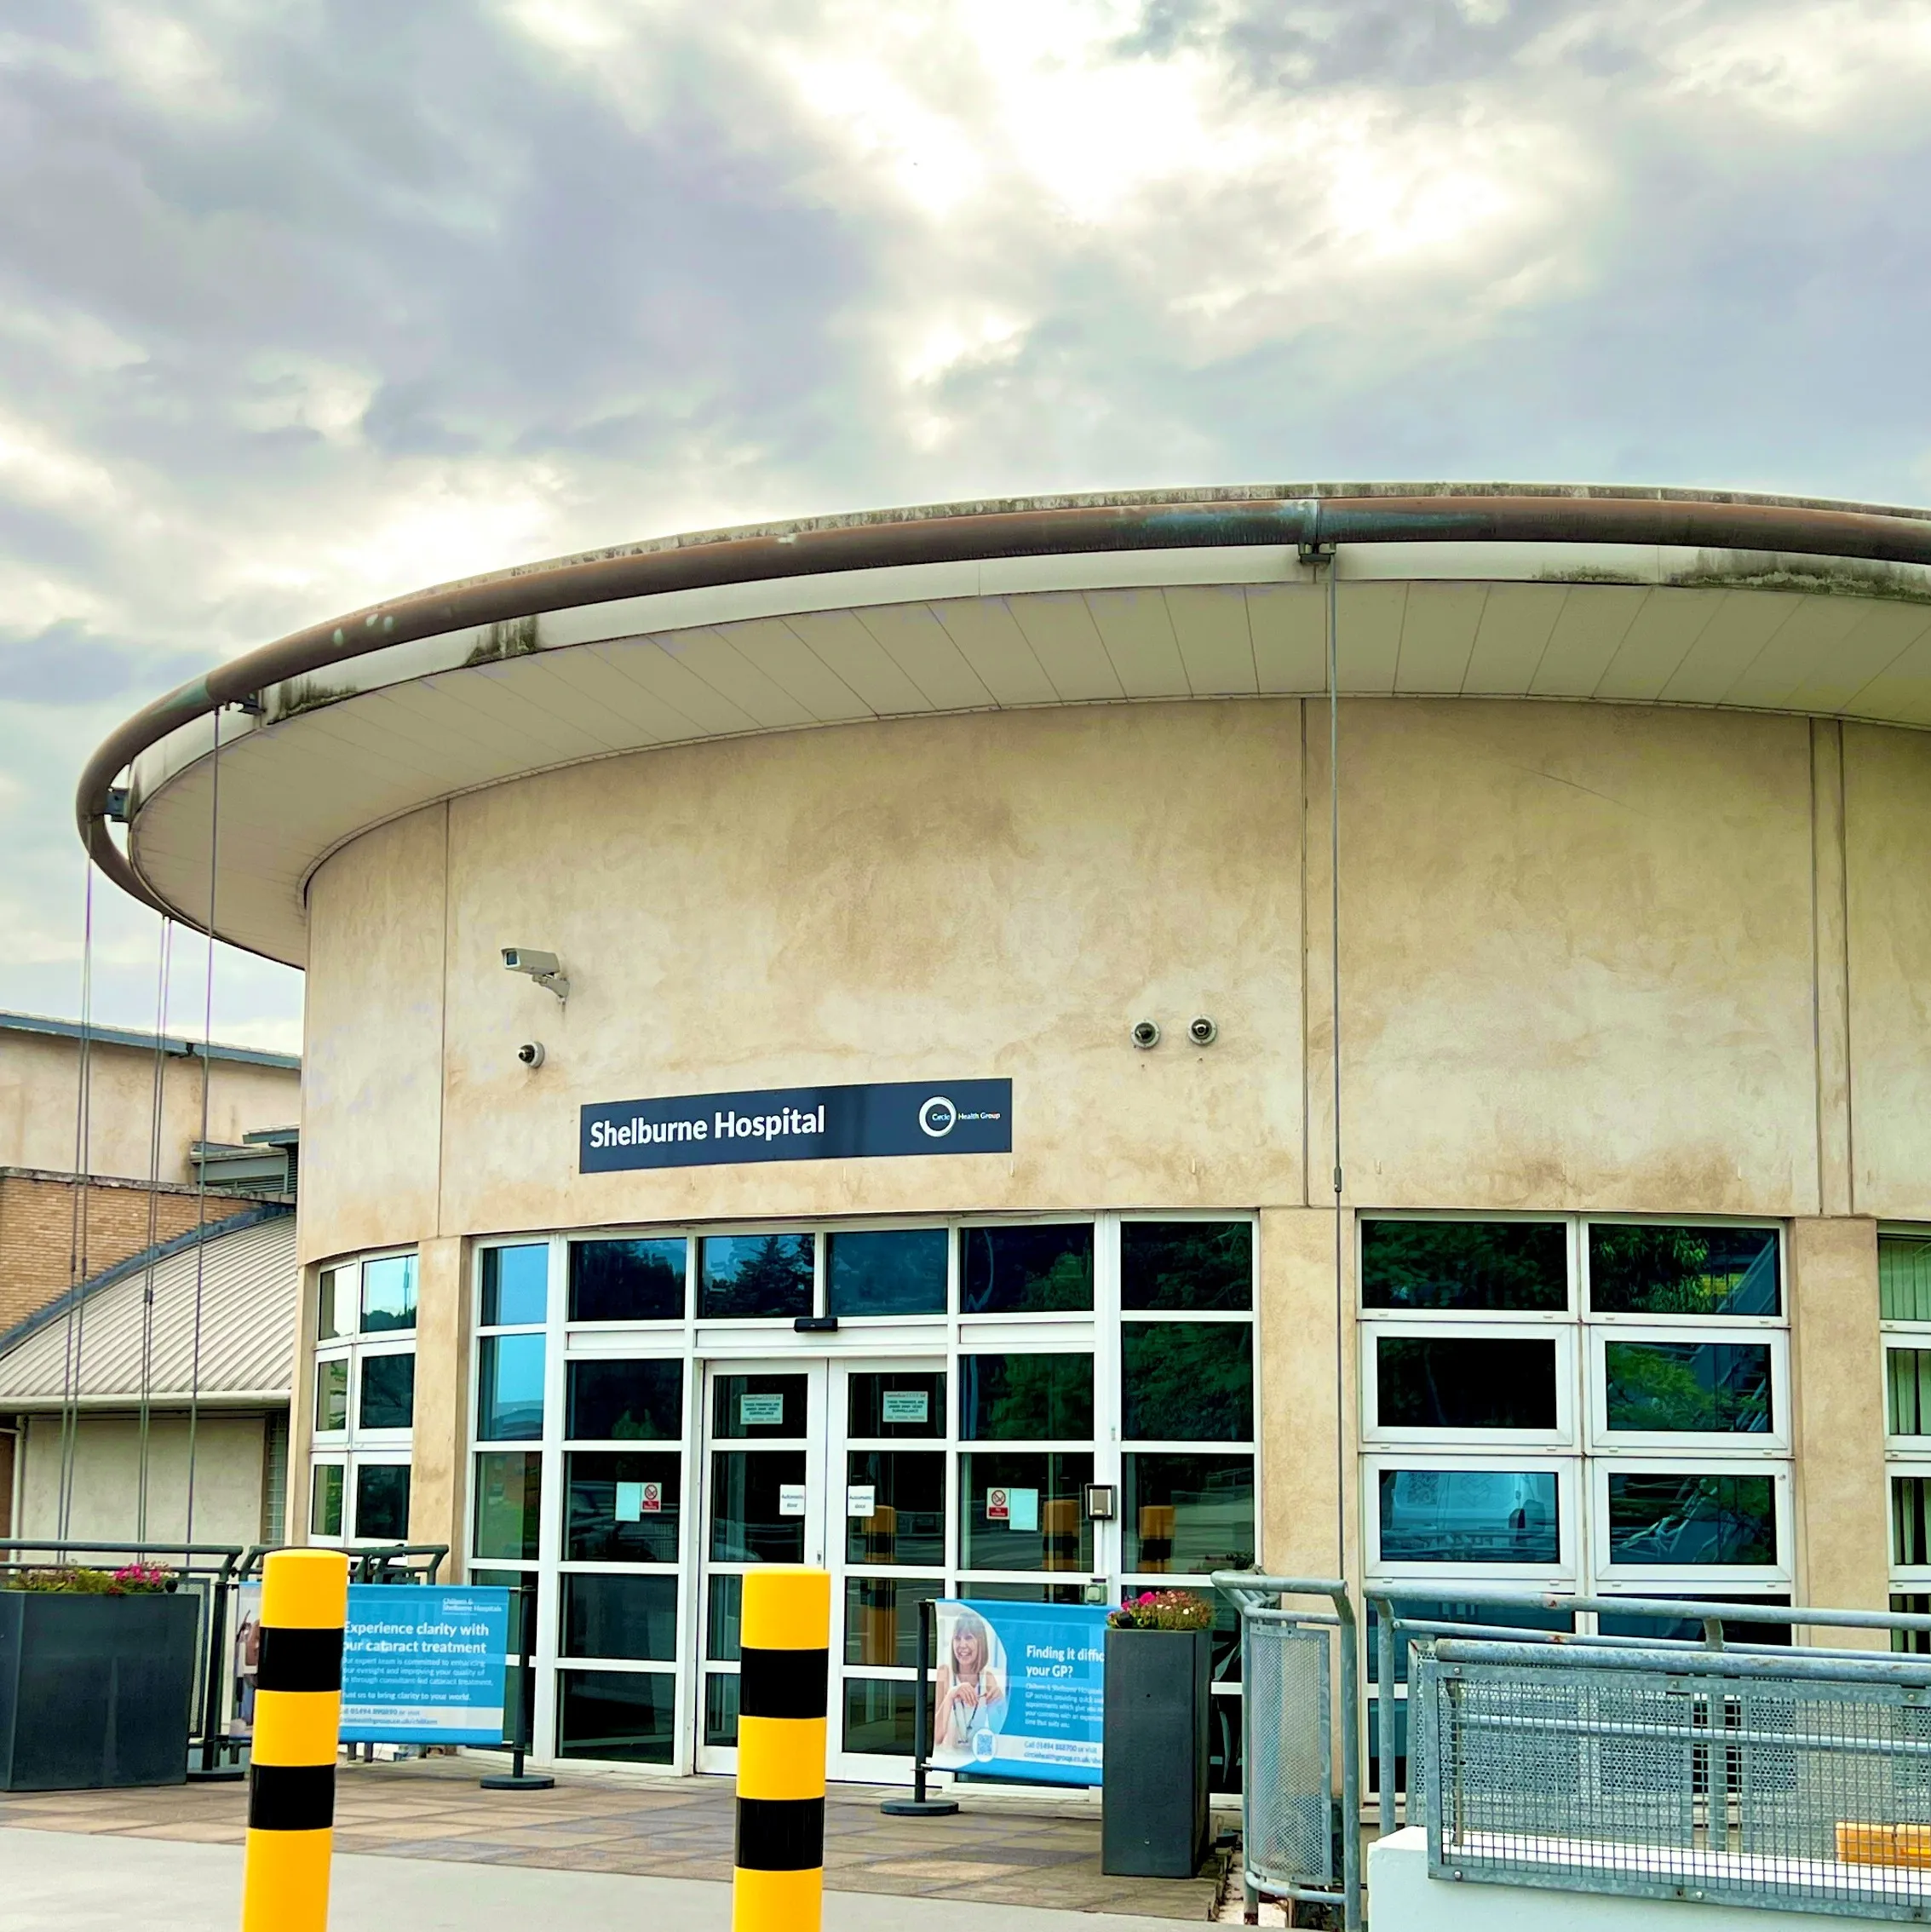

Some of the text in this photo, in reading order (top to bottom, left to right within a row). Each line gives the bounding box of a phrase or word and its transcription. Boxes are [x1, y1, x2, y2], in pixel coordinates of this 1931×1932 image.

[932, 1113, 951, 1121] Circle
[980, 1112, 1001, 1120] Group
[589, 1105, 825, 1147] Shelburne Hospital
[344, 1620, 489, 1637] Experience clarity with
[365, 1641, 418, 1653] cataract
[421, 1642, 486, 1653] treatment
[1026, 1645, 1065, 1662] Finding
[1066, 1647, 1076, 1660] it
[1026, 1665, 1073, 1679] your GP?
